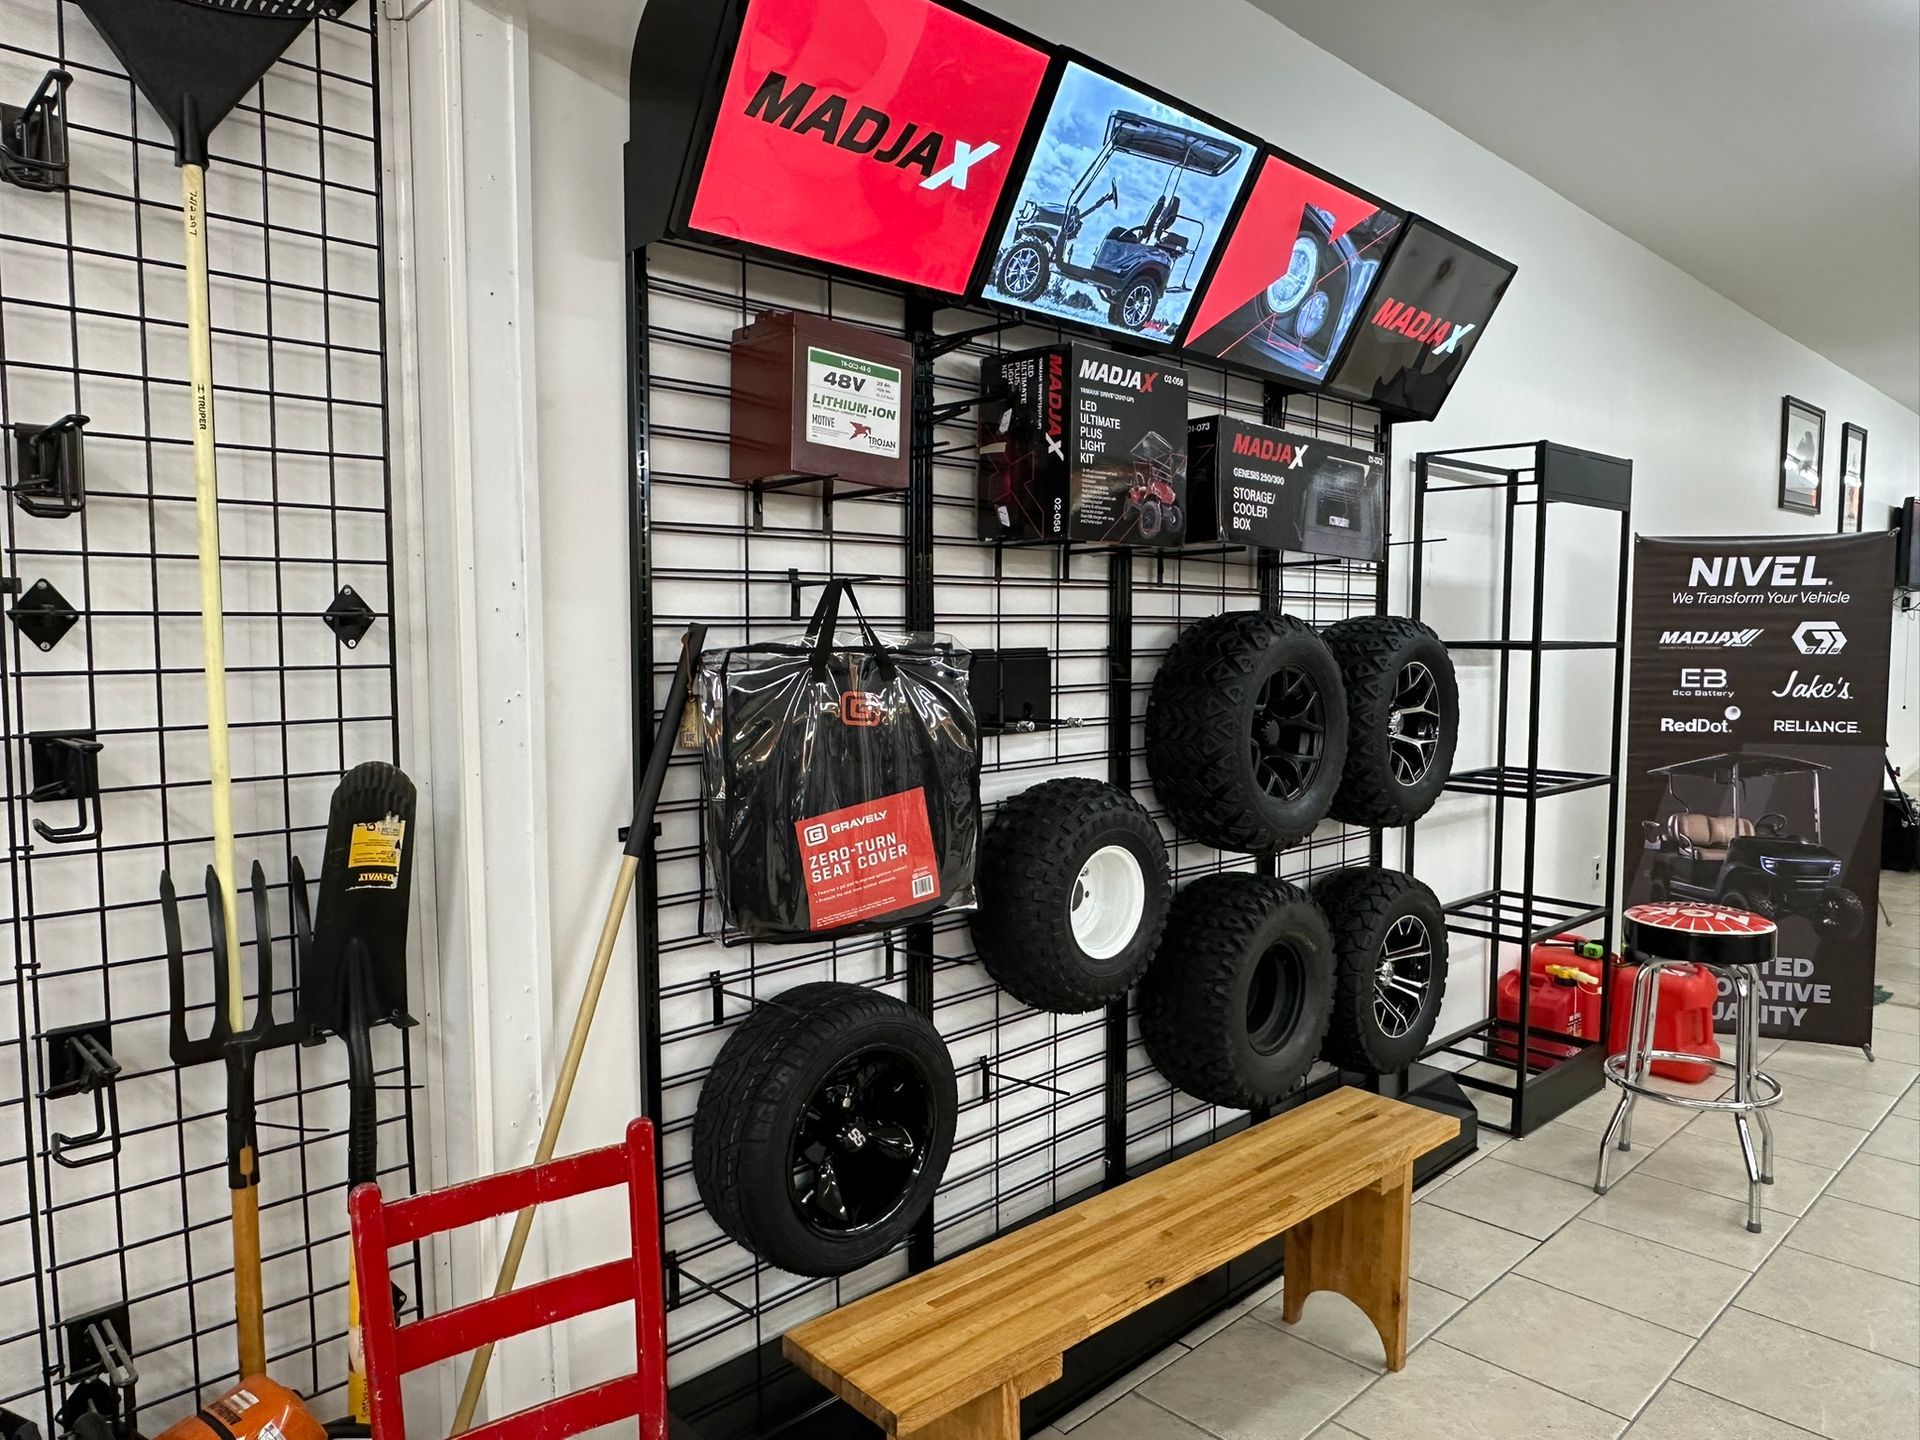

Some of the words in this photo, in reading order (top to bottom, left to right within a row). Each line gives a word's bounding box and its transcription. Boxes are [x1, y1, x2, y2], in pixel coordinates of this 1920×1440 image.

[744, 70, 1001, 191] MADJAX
[1371, 297, 1475, 355] MADJAX
[1027, 359, 1035, 378] LED
[1079, 359, 1158, 393] MADJAX
[823, 371, 866, 392] 48V
[1020, 360, 1028, 405] ULTIMATE
[198, 395, 206, 430] TRUPER
[812, 393, 897, 420] LITHIUM-ION
[1045, 353, 1065, 462] MADJAX
[1080, 400, 1097, 412] LED
[812, 413, 836, 428] MOTIVE
[1080, 413, 1121, 430] ULTIMATE
[868, 435, 896, 449] TROJAN
[1080, 426, 1103, 440] PLUS
[1080, 440, 1106, 453] LIGHT
[1233, 433, 1309, 469] MADJAX
[1080, 453, 1095, 465] KIT
[1233, 467, 1260, 481] GENESIS
[1233, 486, 1275, 505] STORAGE/
[1052, 497, 1062, 533] 02-058
[1233, 502, 1268, 518] COOLER
[1233, 517, 1251, 531] BOX
[1688, 556, 1828, 587] NIVEL
[1672, 592, 1694, 604] We
[1697, 592, 1764, 604] Transform
[1767, 592, 1797, 604] Your
[1801, 591, 1850, 604] Vehicle
[1659, 629, 1765, 647] MADJAX
[1681, 668, 1728, 688] EB
[1772, 670, 1850, 699] Jake's
[1694, 690, 1735, 698] Battery
[1661, 718, 1729, 733] RedDot
[1773, 720, 1858, 733] RELIANCE
[831, 810, 888, 834] GRAVELY
[809, 832, 897, 870] ZERO-TURN
[812, 861, 851, 883] SEAT
[858, 843, 908, 869] COVER
